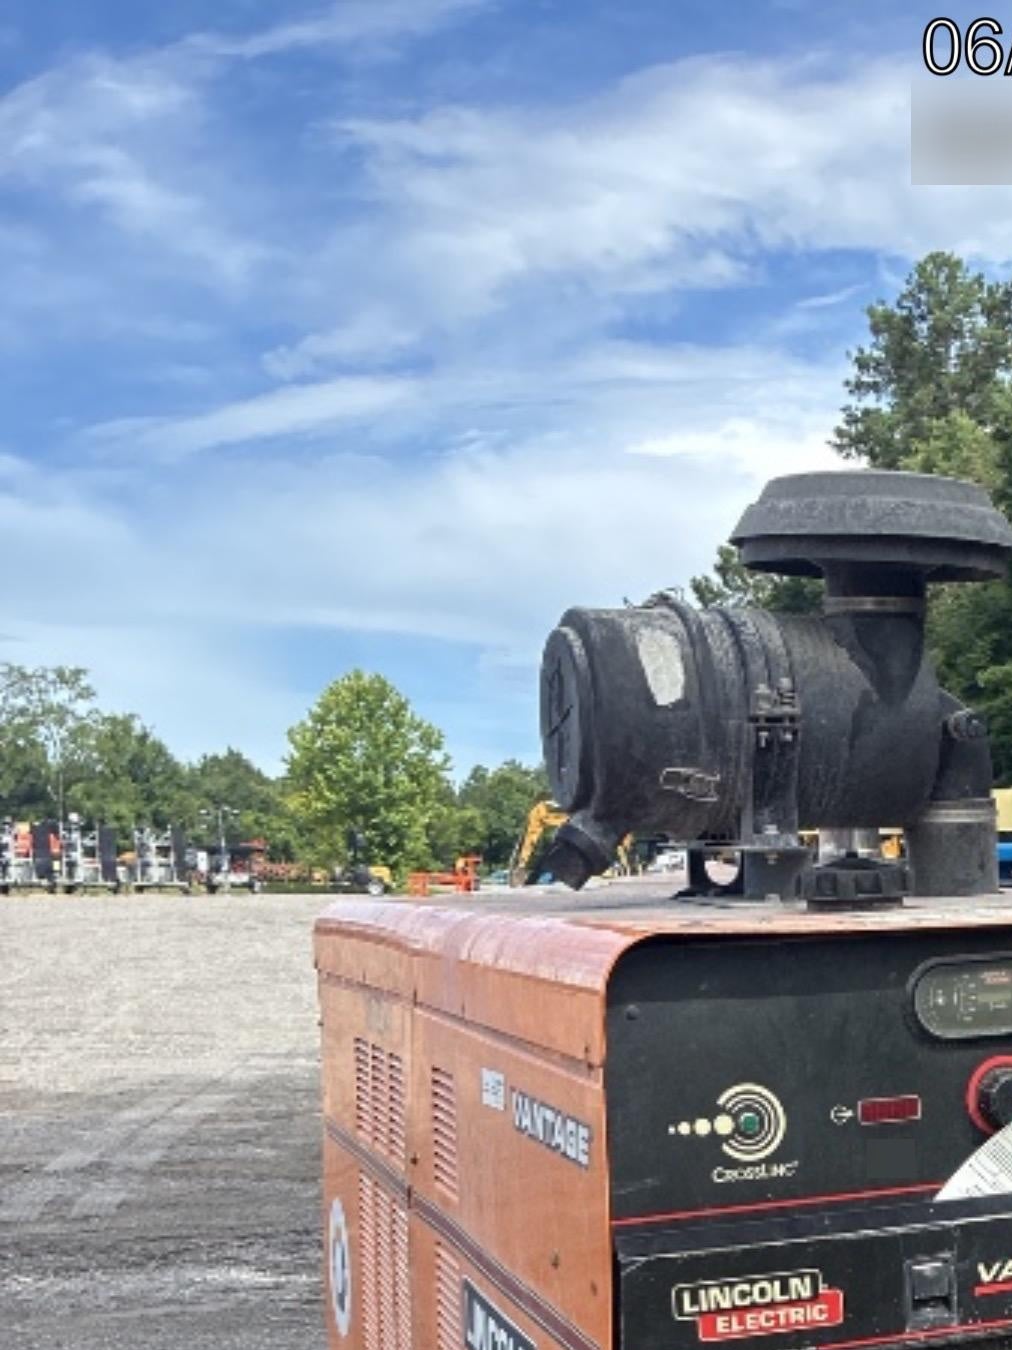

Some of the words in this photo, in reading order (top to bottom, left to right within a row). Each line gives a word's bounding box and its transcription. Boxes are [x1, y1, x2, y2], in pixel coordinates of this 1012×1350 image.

[511, 1090, 590, 1166] VANTAGE
[682, 1274, 812, 1313] LINCOLN
[716, 1303, 829, 1333] ELECTRIC
